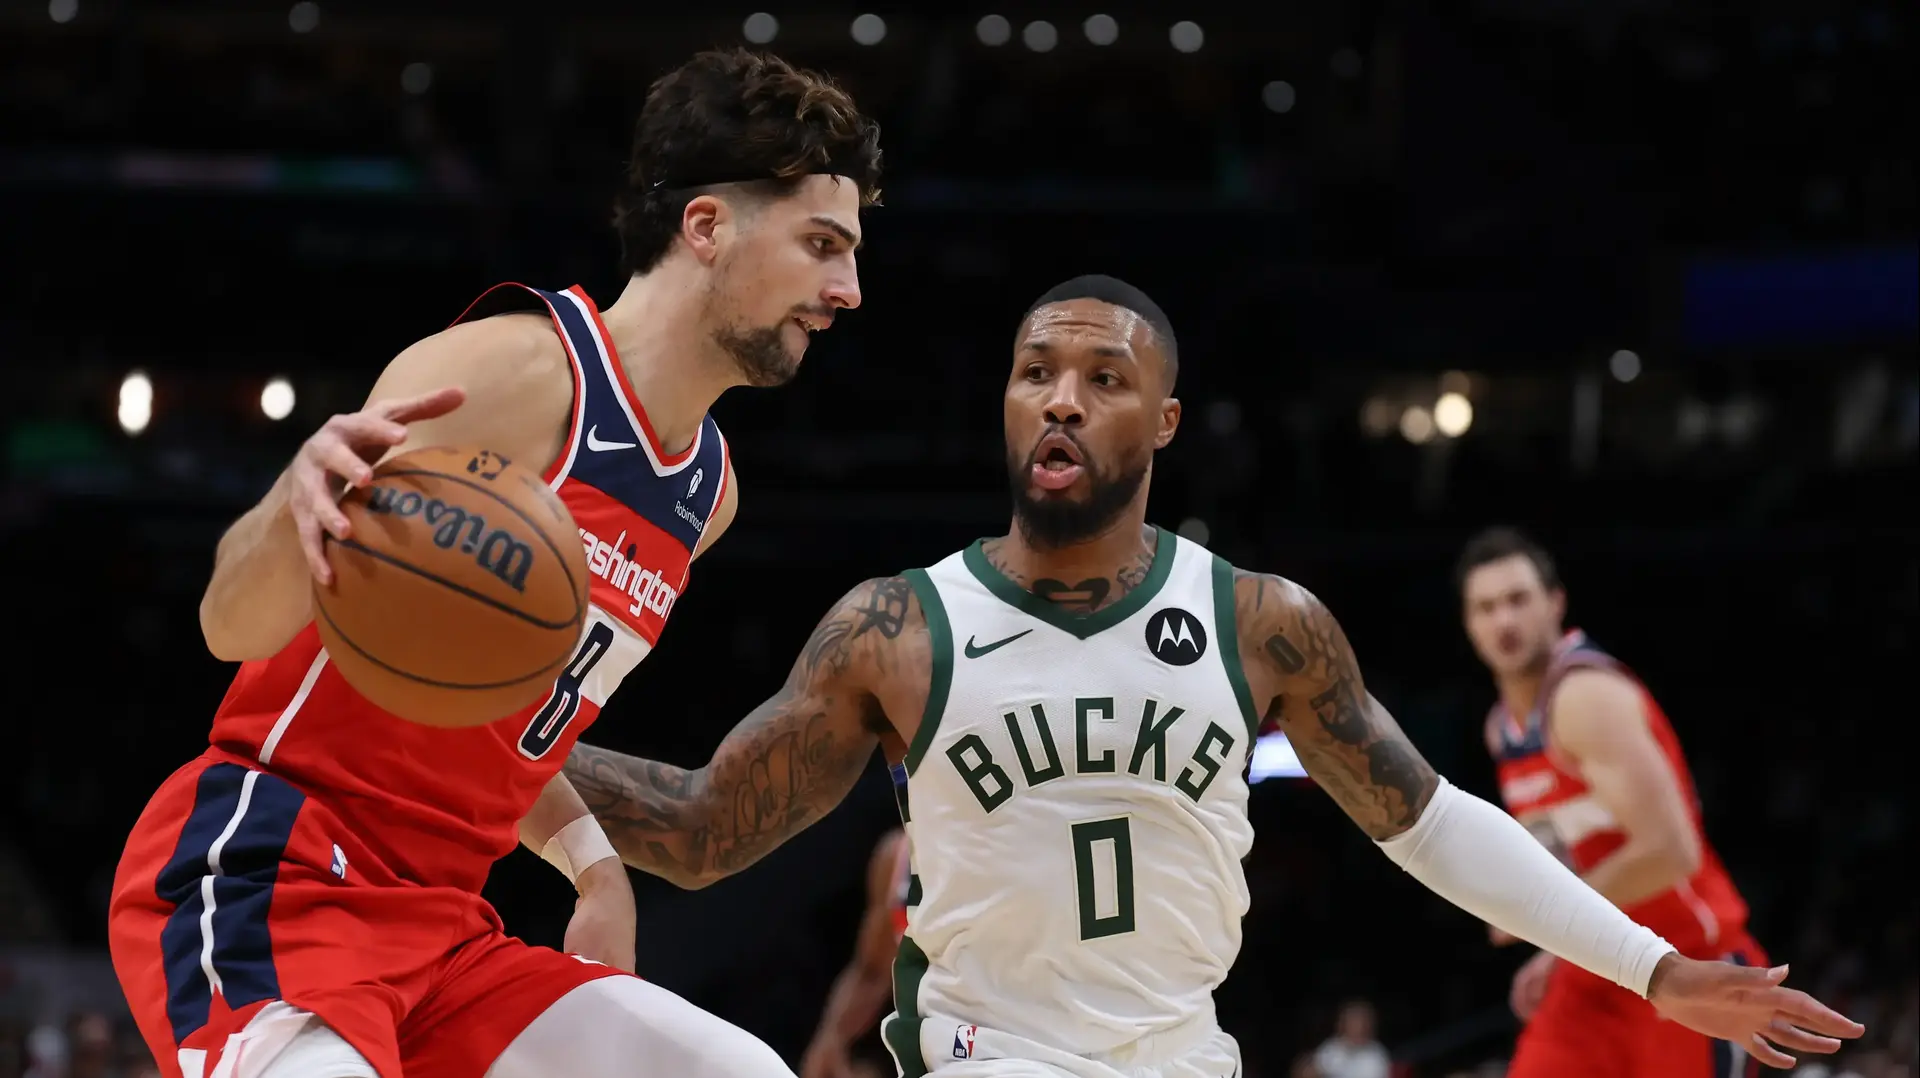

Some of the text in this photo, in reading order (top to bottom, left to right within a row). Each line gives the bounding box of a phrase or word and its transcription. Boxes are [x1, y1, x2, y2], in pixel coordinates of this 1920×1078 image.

[367, 485, 534, 594] Wilson
[674, 500, 704, 533] Robinhood
[578, 529, 677, 622] ashington
[517, 620, 614, 761] 8
[944, 696, 1236, 815] BUCKS
[1069, 814, 1137, 943] 0
